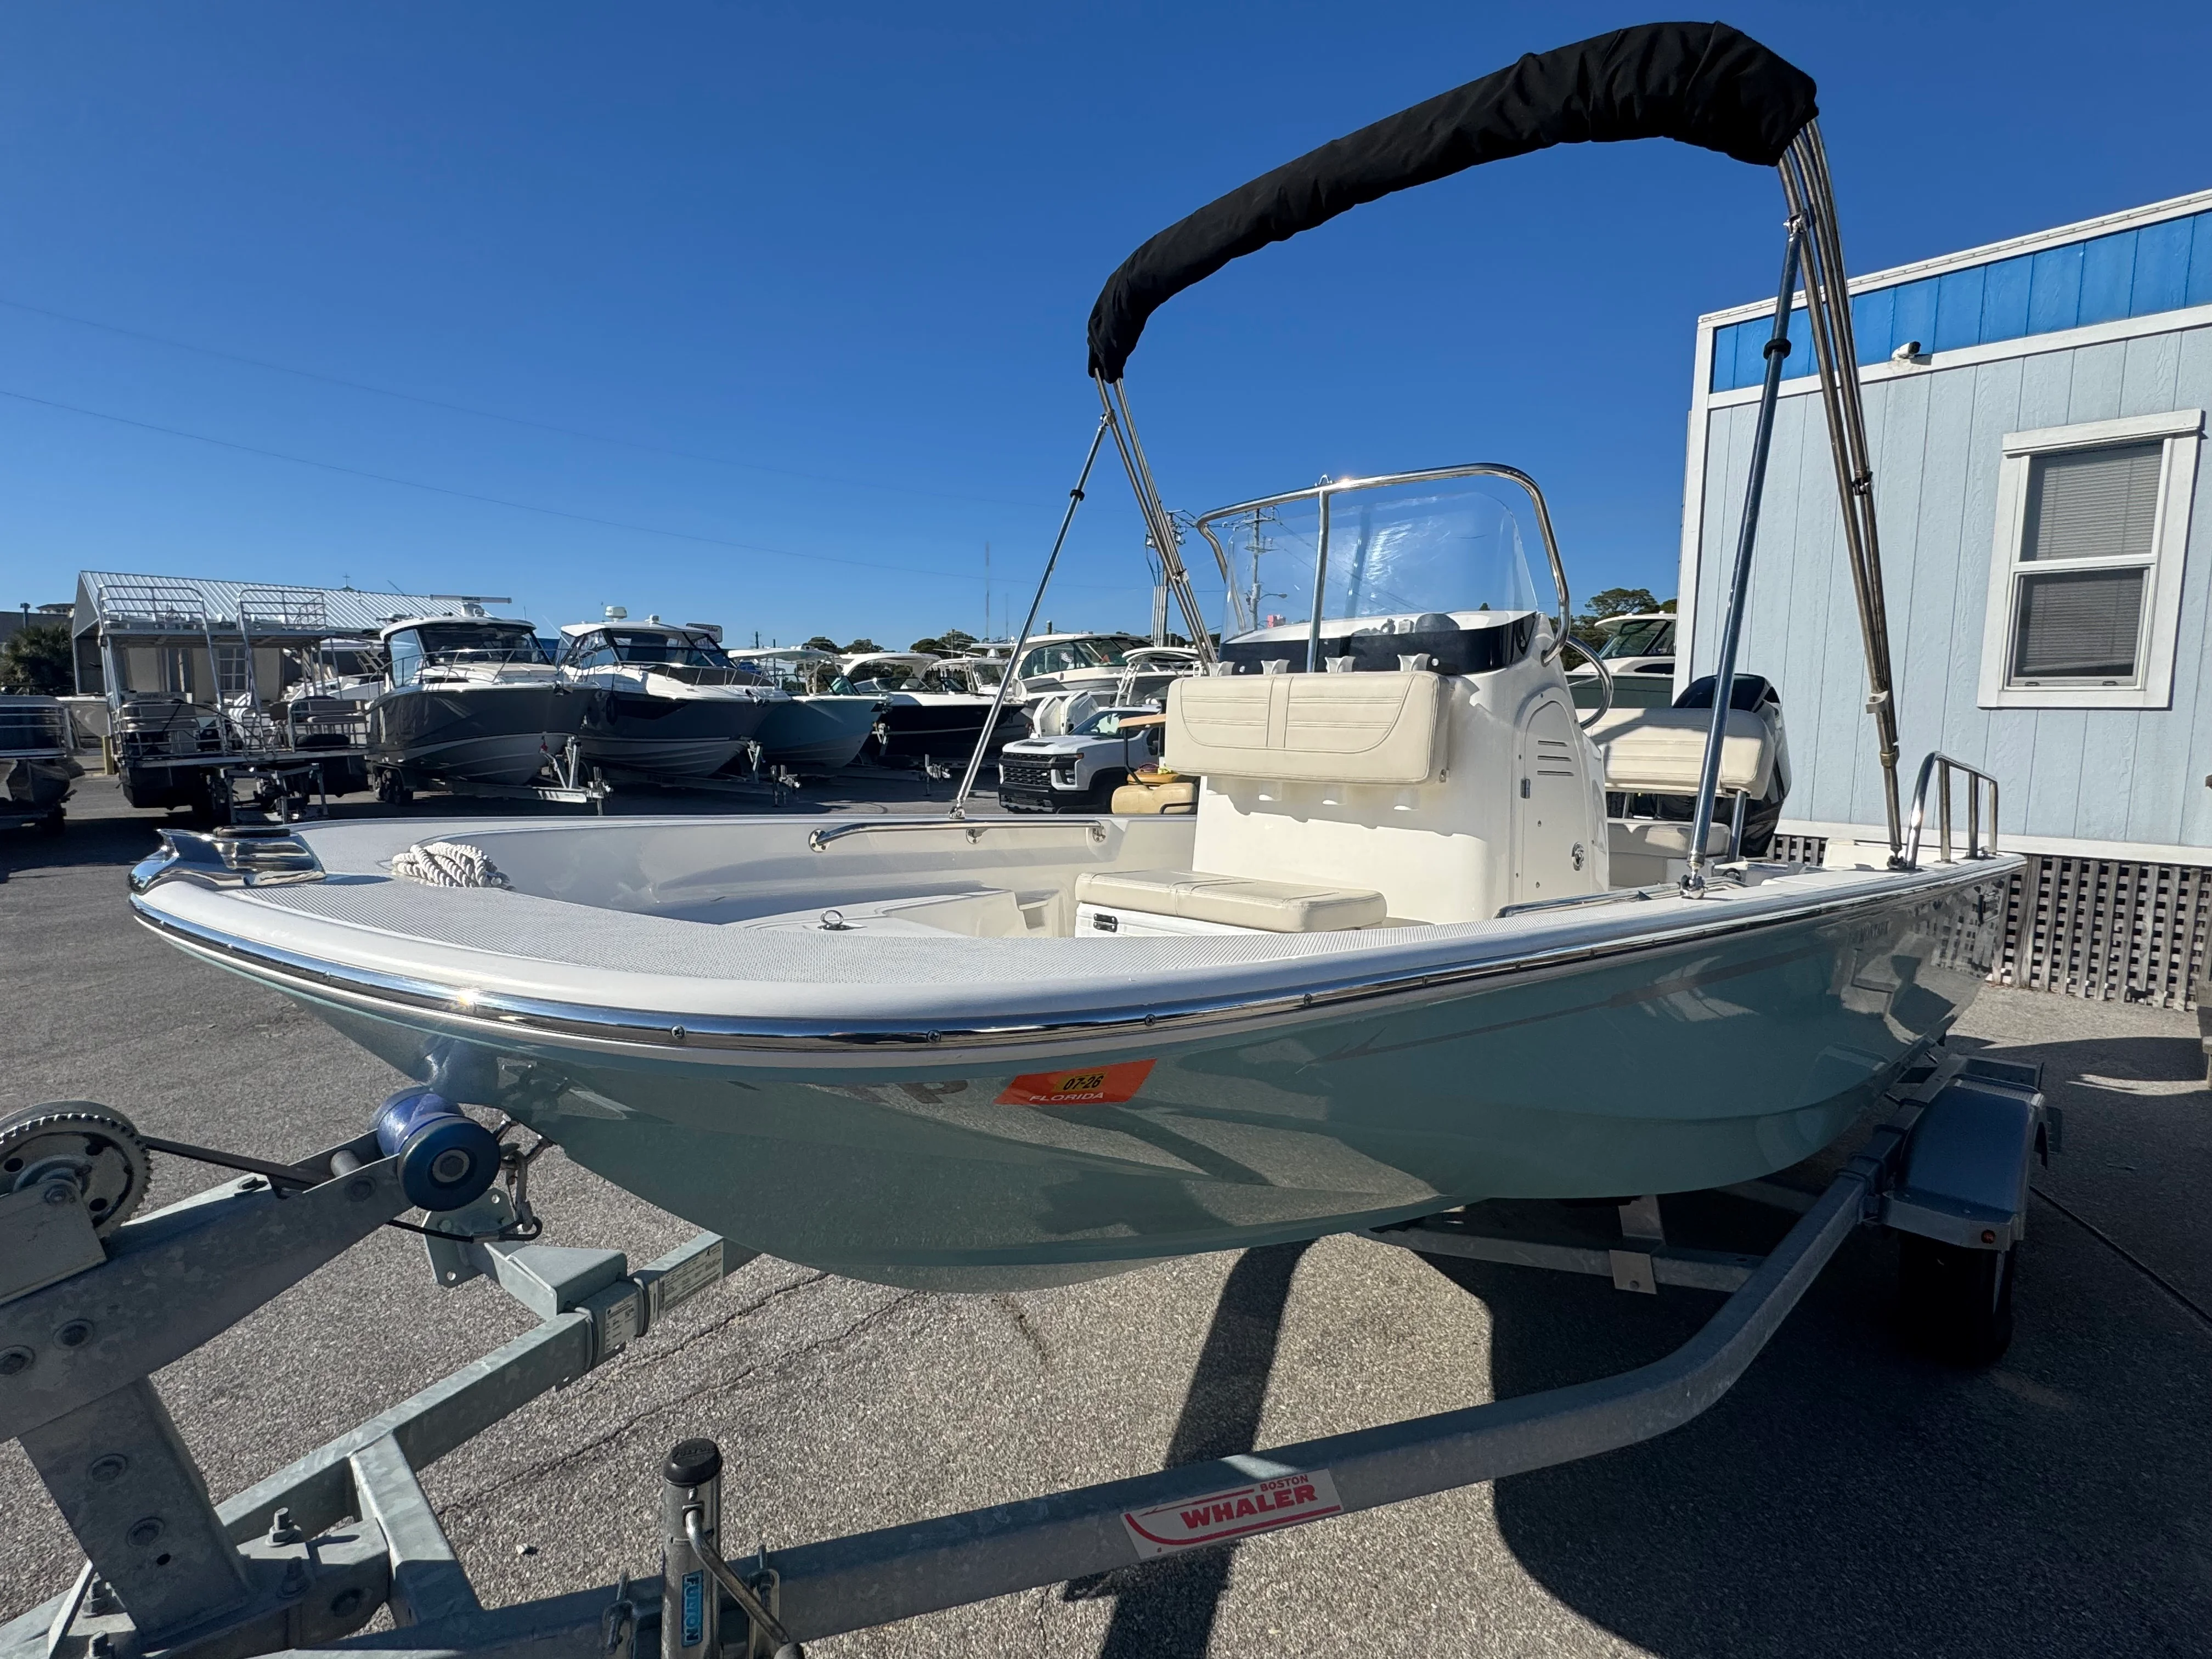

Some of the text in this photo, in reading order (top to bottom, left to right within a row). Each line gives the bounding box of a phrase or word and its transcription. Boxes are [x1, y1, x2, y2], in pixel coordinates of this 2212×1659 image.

[1063, 1075, 1104, 1091] 07-26
[1029, 1092, 1104, 1102] FLORIDA
[1260, 1474, 1310, 1492] BOSTON
[1180, 1484, 1318, 1530] WHALER
[686, 1576, 699, 1640] FULTON
